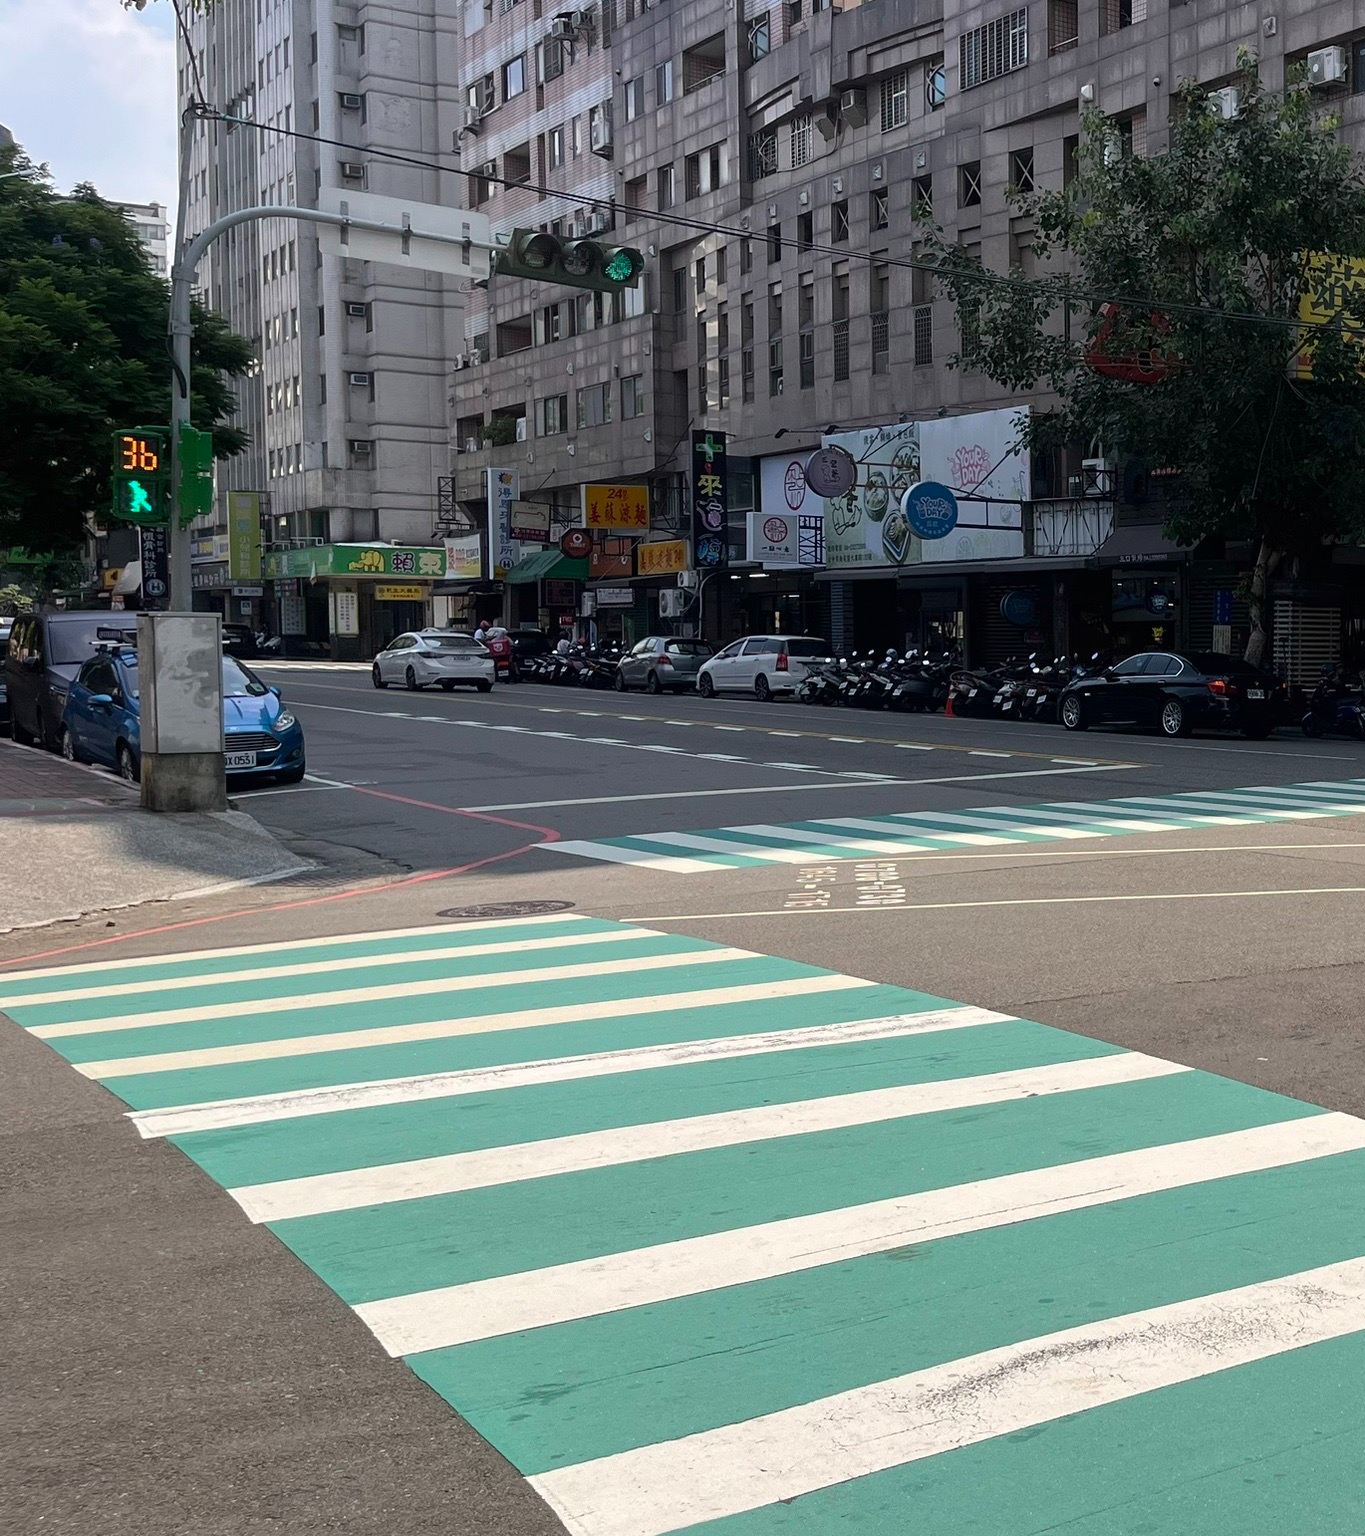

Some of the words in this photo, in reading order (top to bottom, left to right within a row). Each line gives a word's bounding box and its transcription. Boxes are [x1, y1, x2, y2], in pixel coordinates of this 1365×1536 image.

[955, 445, 985, 467] YOUR
[961, 466, 981, 485] DAY
[920, 497, 946, 508] YOUR
